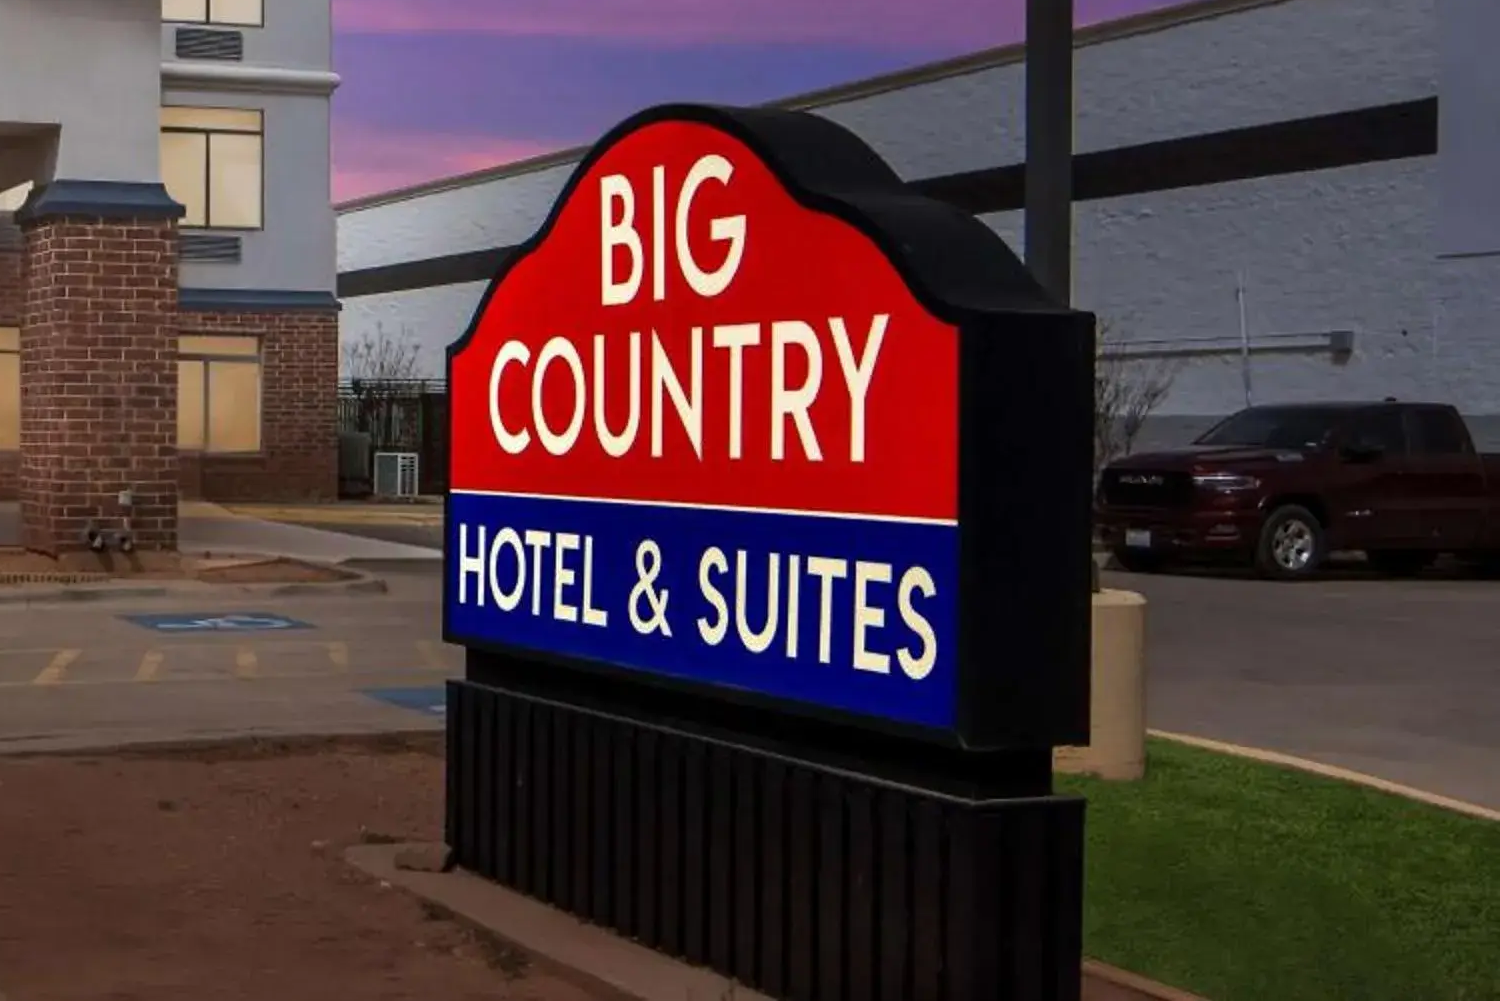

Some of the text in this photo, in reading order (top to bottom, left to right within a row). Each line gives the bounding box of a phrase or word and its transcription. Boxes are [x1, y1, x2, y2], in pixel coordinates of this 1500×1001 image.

[600, 154, 747, 306] BIG
[489, 314, 889, 463] COUNTRY
[458, 523, 937, 680] HOTEL & SUITES
